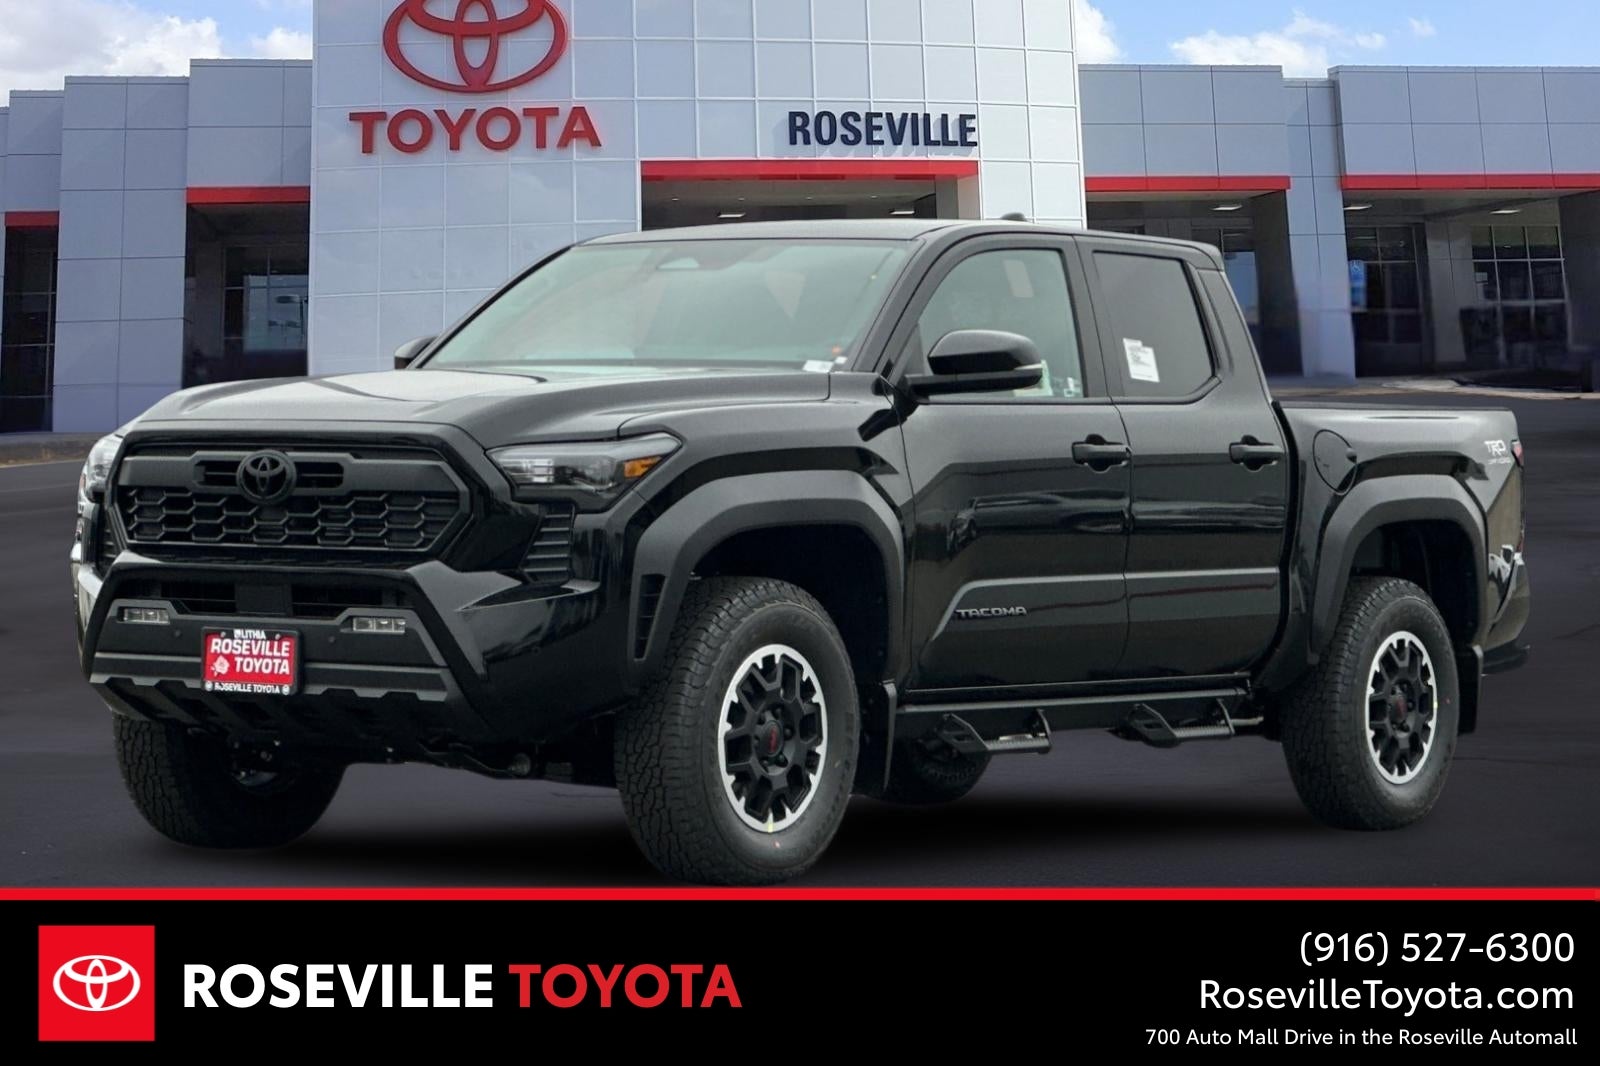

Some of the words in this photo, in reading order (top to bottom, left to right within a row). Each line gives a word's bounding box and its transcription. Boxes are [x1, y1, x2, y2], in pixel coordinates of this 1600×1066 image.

[349, 106, 602, 154] TOYOTA
[788, 111, 978, 147] ROSEVILLE
[1484, 440, 1506, 456] TRD
[955, 606, 1028, 618] TACOMA
[241, 630, 266, 640] LITHIA
[210, 638, 290, 657] ROSEVILLE
[234, 656, 290, 675] TOYOTA
[214, 683, 251, 692] ROSEVILLE
[253, 684, 280, 693] TOYOTA
